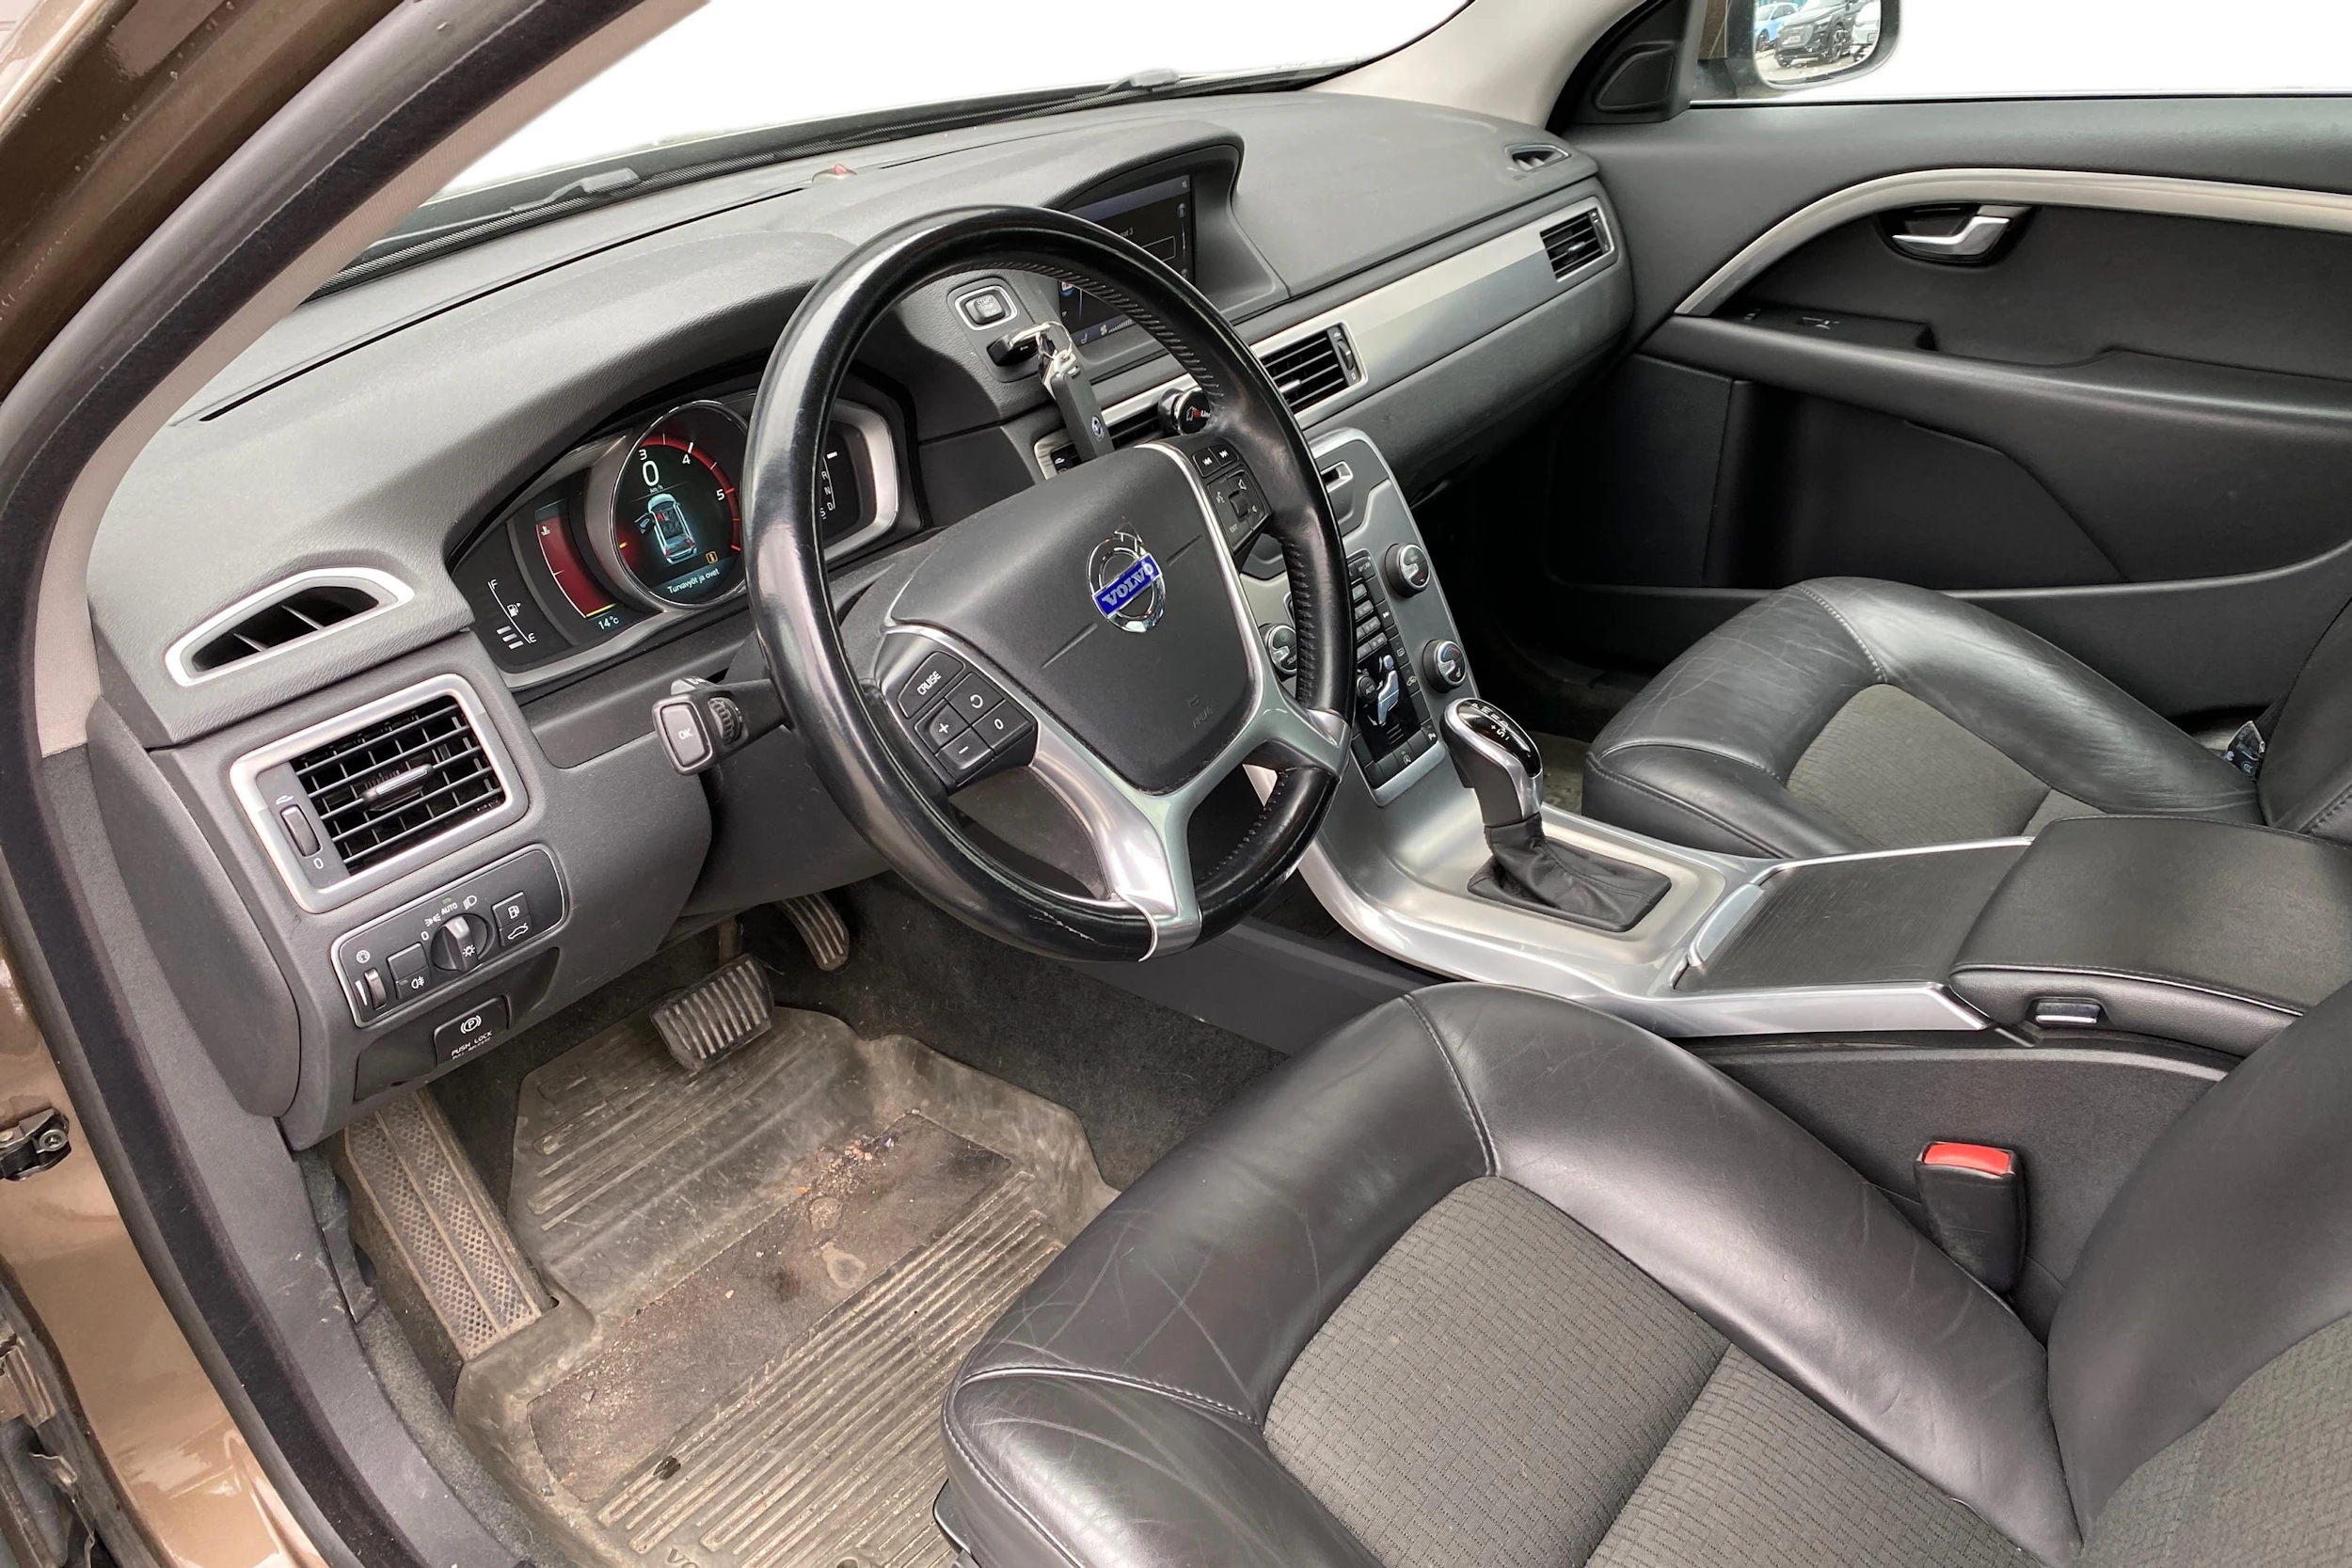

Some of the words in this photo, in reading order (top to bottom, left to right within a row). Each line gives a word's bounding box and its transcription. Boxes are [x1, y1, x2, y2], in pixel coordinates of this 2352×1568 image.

[639, 449, 648, 461] 3
[682, 453, 691, 465] 4
[642, 460, 660, 487] 0
[820, 470, 829, 480] R
[716, 488, 725, 501] 5
[824, 485, 832, 495] N
[827, 501, 834, 511] D
[490, 578, 498, 590] F
[667, 577, 699, 594] Turvavyöt
[698, 574, 706, 583] ja
[705, 567, 721, 579] ovet
[1102, 562, 1154, 607] VOLVO
[528, 632, 537, 643] E
[916, 671, 942, 696] CRUISE
[993, 718, 1004, 730] 0
[677, 727, 693, 740] OK
[313, 857, 324, 870] 0
[440, 901, 458, 915] AUTO
[421, 930, 430, 942] 0
[452, 1042, 470, 1056] PUSH
[474, 1030, 493, 1044] LOCK
